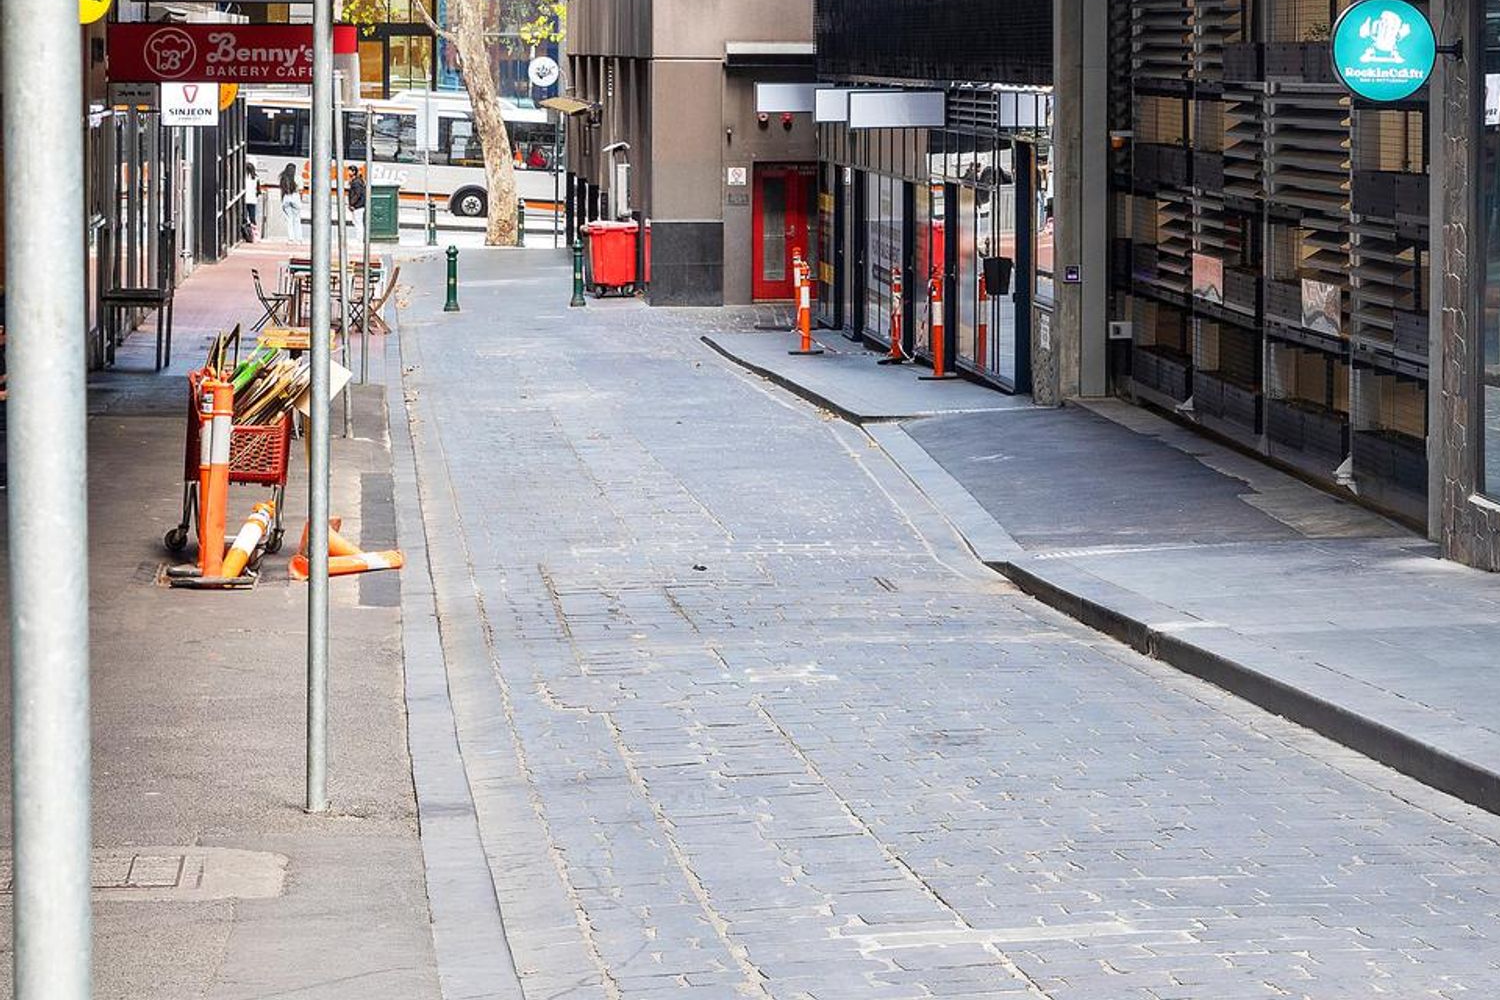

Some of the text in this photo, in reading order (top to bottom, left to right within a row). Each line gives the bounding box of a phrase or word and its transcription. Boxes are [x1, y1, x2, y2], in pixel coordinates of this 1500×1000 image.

[206, 32, 313, 67] Benny's
[206, 66, 269, 77] BAKERY
[169, 108, 212, 116] SINJEON
